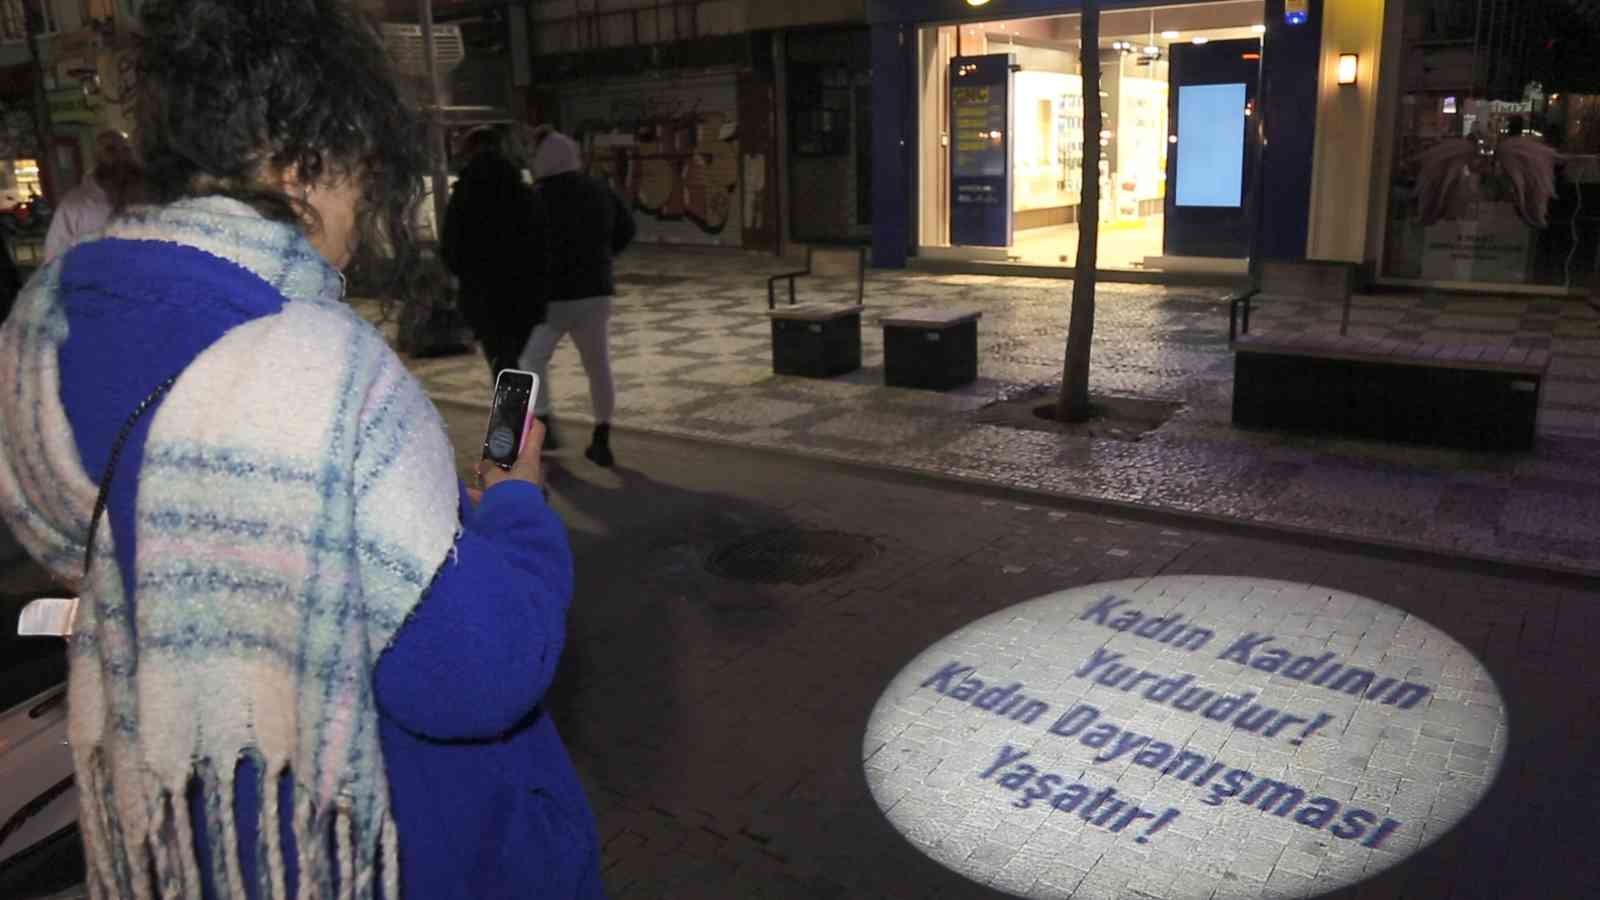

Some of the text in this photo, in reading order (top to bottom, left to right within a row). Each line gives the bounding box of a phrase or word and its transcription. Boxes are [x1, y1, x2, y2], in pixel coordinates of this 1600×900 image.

[1074, 648, 1335, 746] Yurdudur!
[1080, 595, 1431, 709] Kadın Kadının
[920, 661, 1402, 849] Kadın Dayanışması
[979, 745, 1180, 844] Yaşatır!
